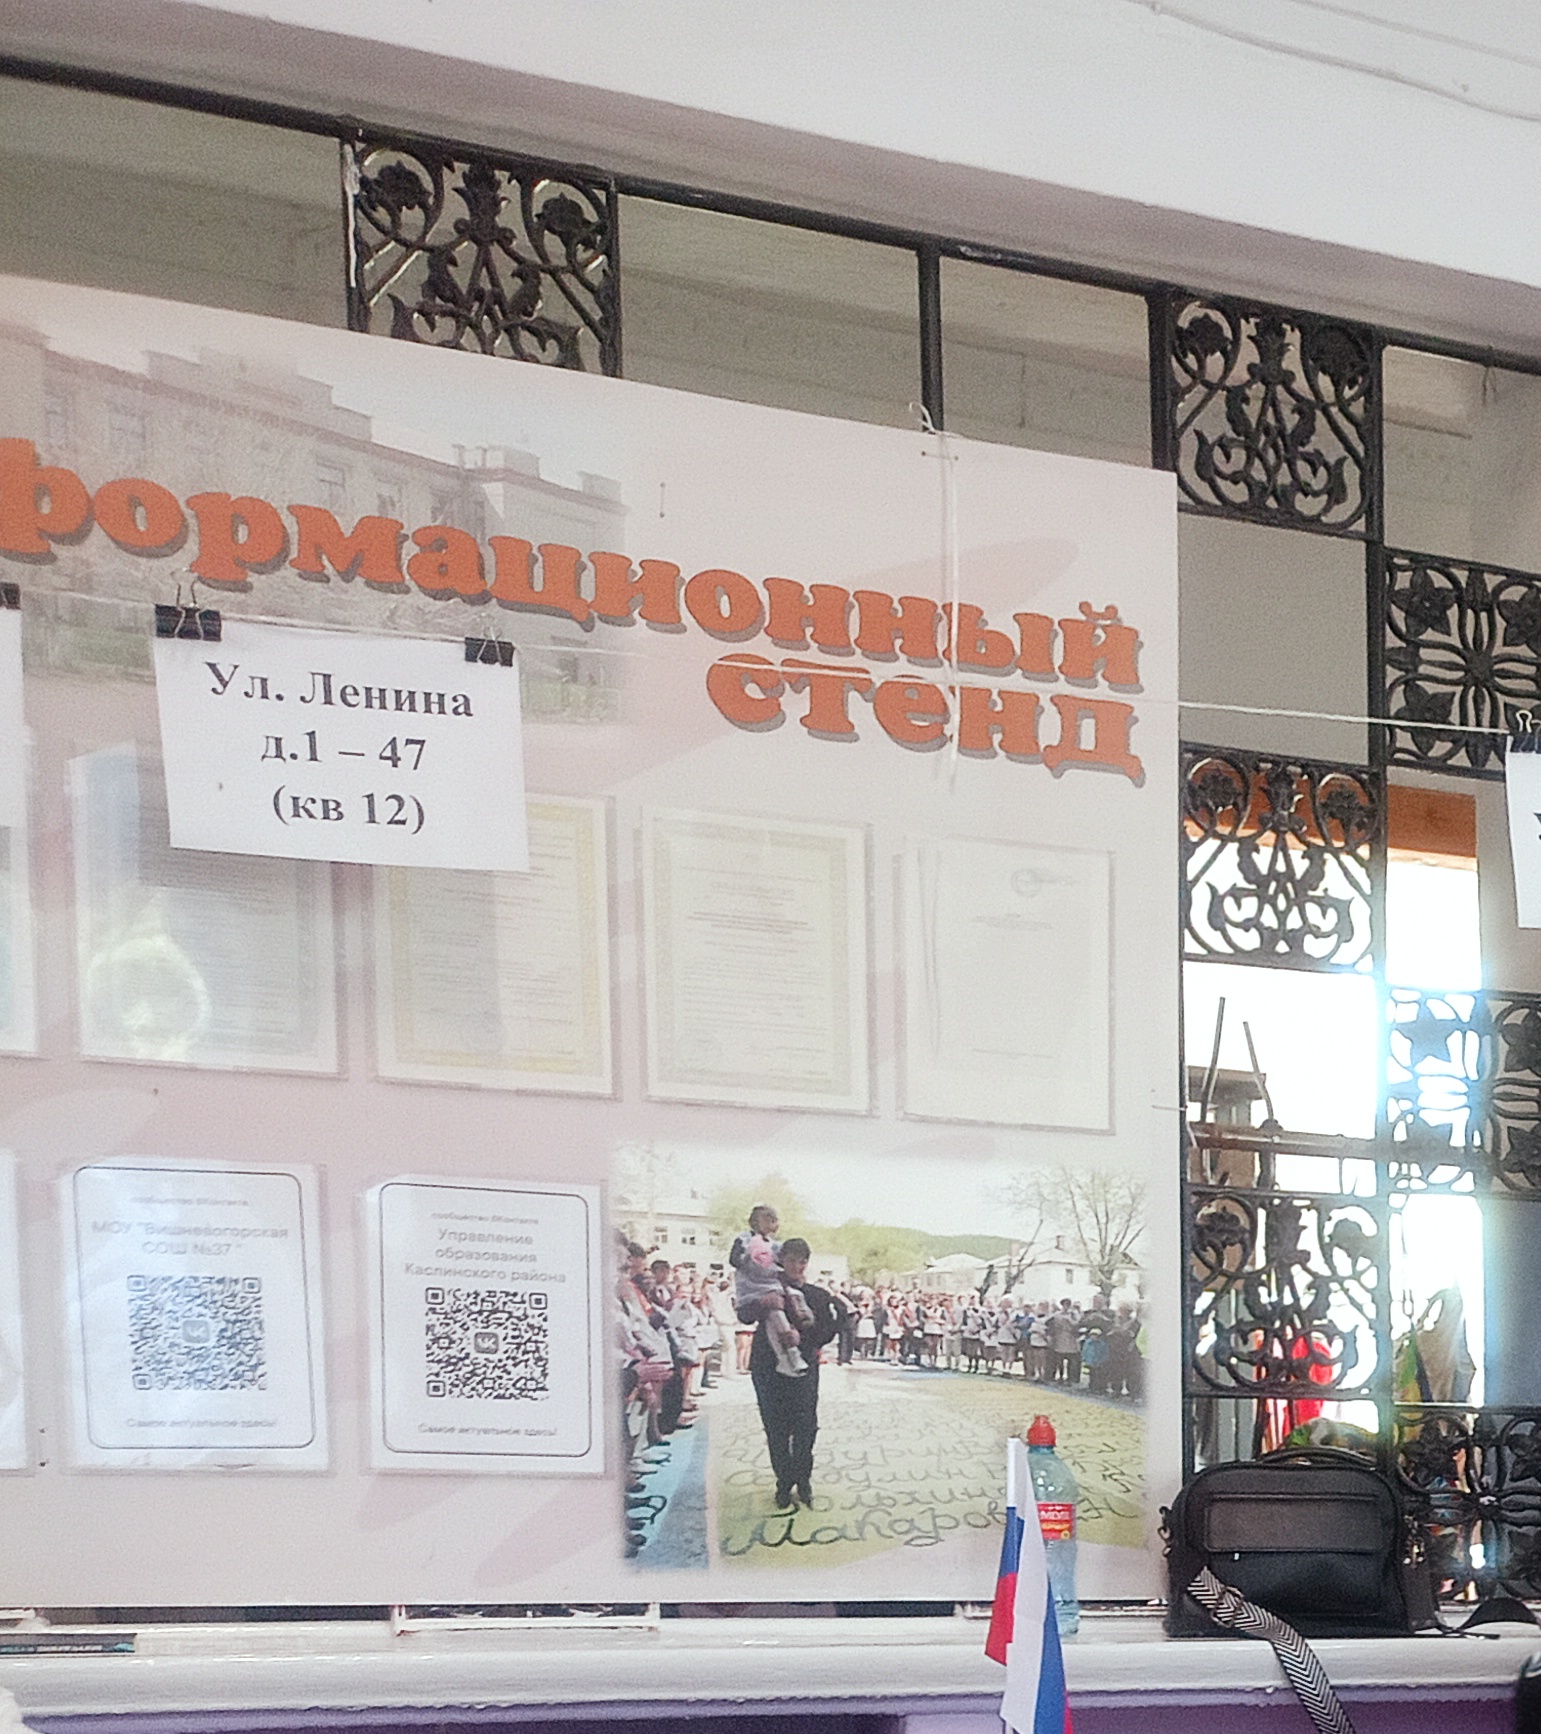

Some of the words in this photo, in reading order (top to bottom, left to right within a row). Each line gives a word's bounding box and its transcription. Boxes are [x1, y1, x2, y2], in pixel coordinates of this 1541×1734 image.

[205, 661, 284, 701] Ул.
[300, 671, 474, 717] Ленина
[706, 653, 1146, 786] стенд
[261, 730, 322, 763] д.1
[378, 736, 426, 770] 47
[273, 785, 344, 826] (кв
[362, 792, 425, 835] 12)
[434, 1245, 538, 1263] образования
[437, 1227, 534, 1245] Управление
[404, 1262, 507, 1280] Каслинского
[510, 1267, 567, 1284] района
